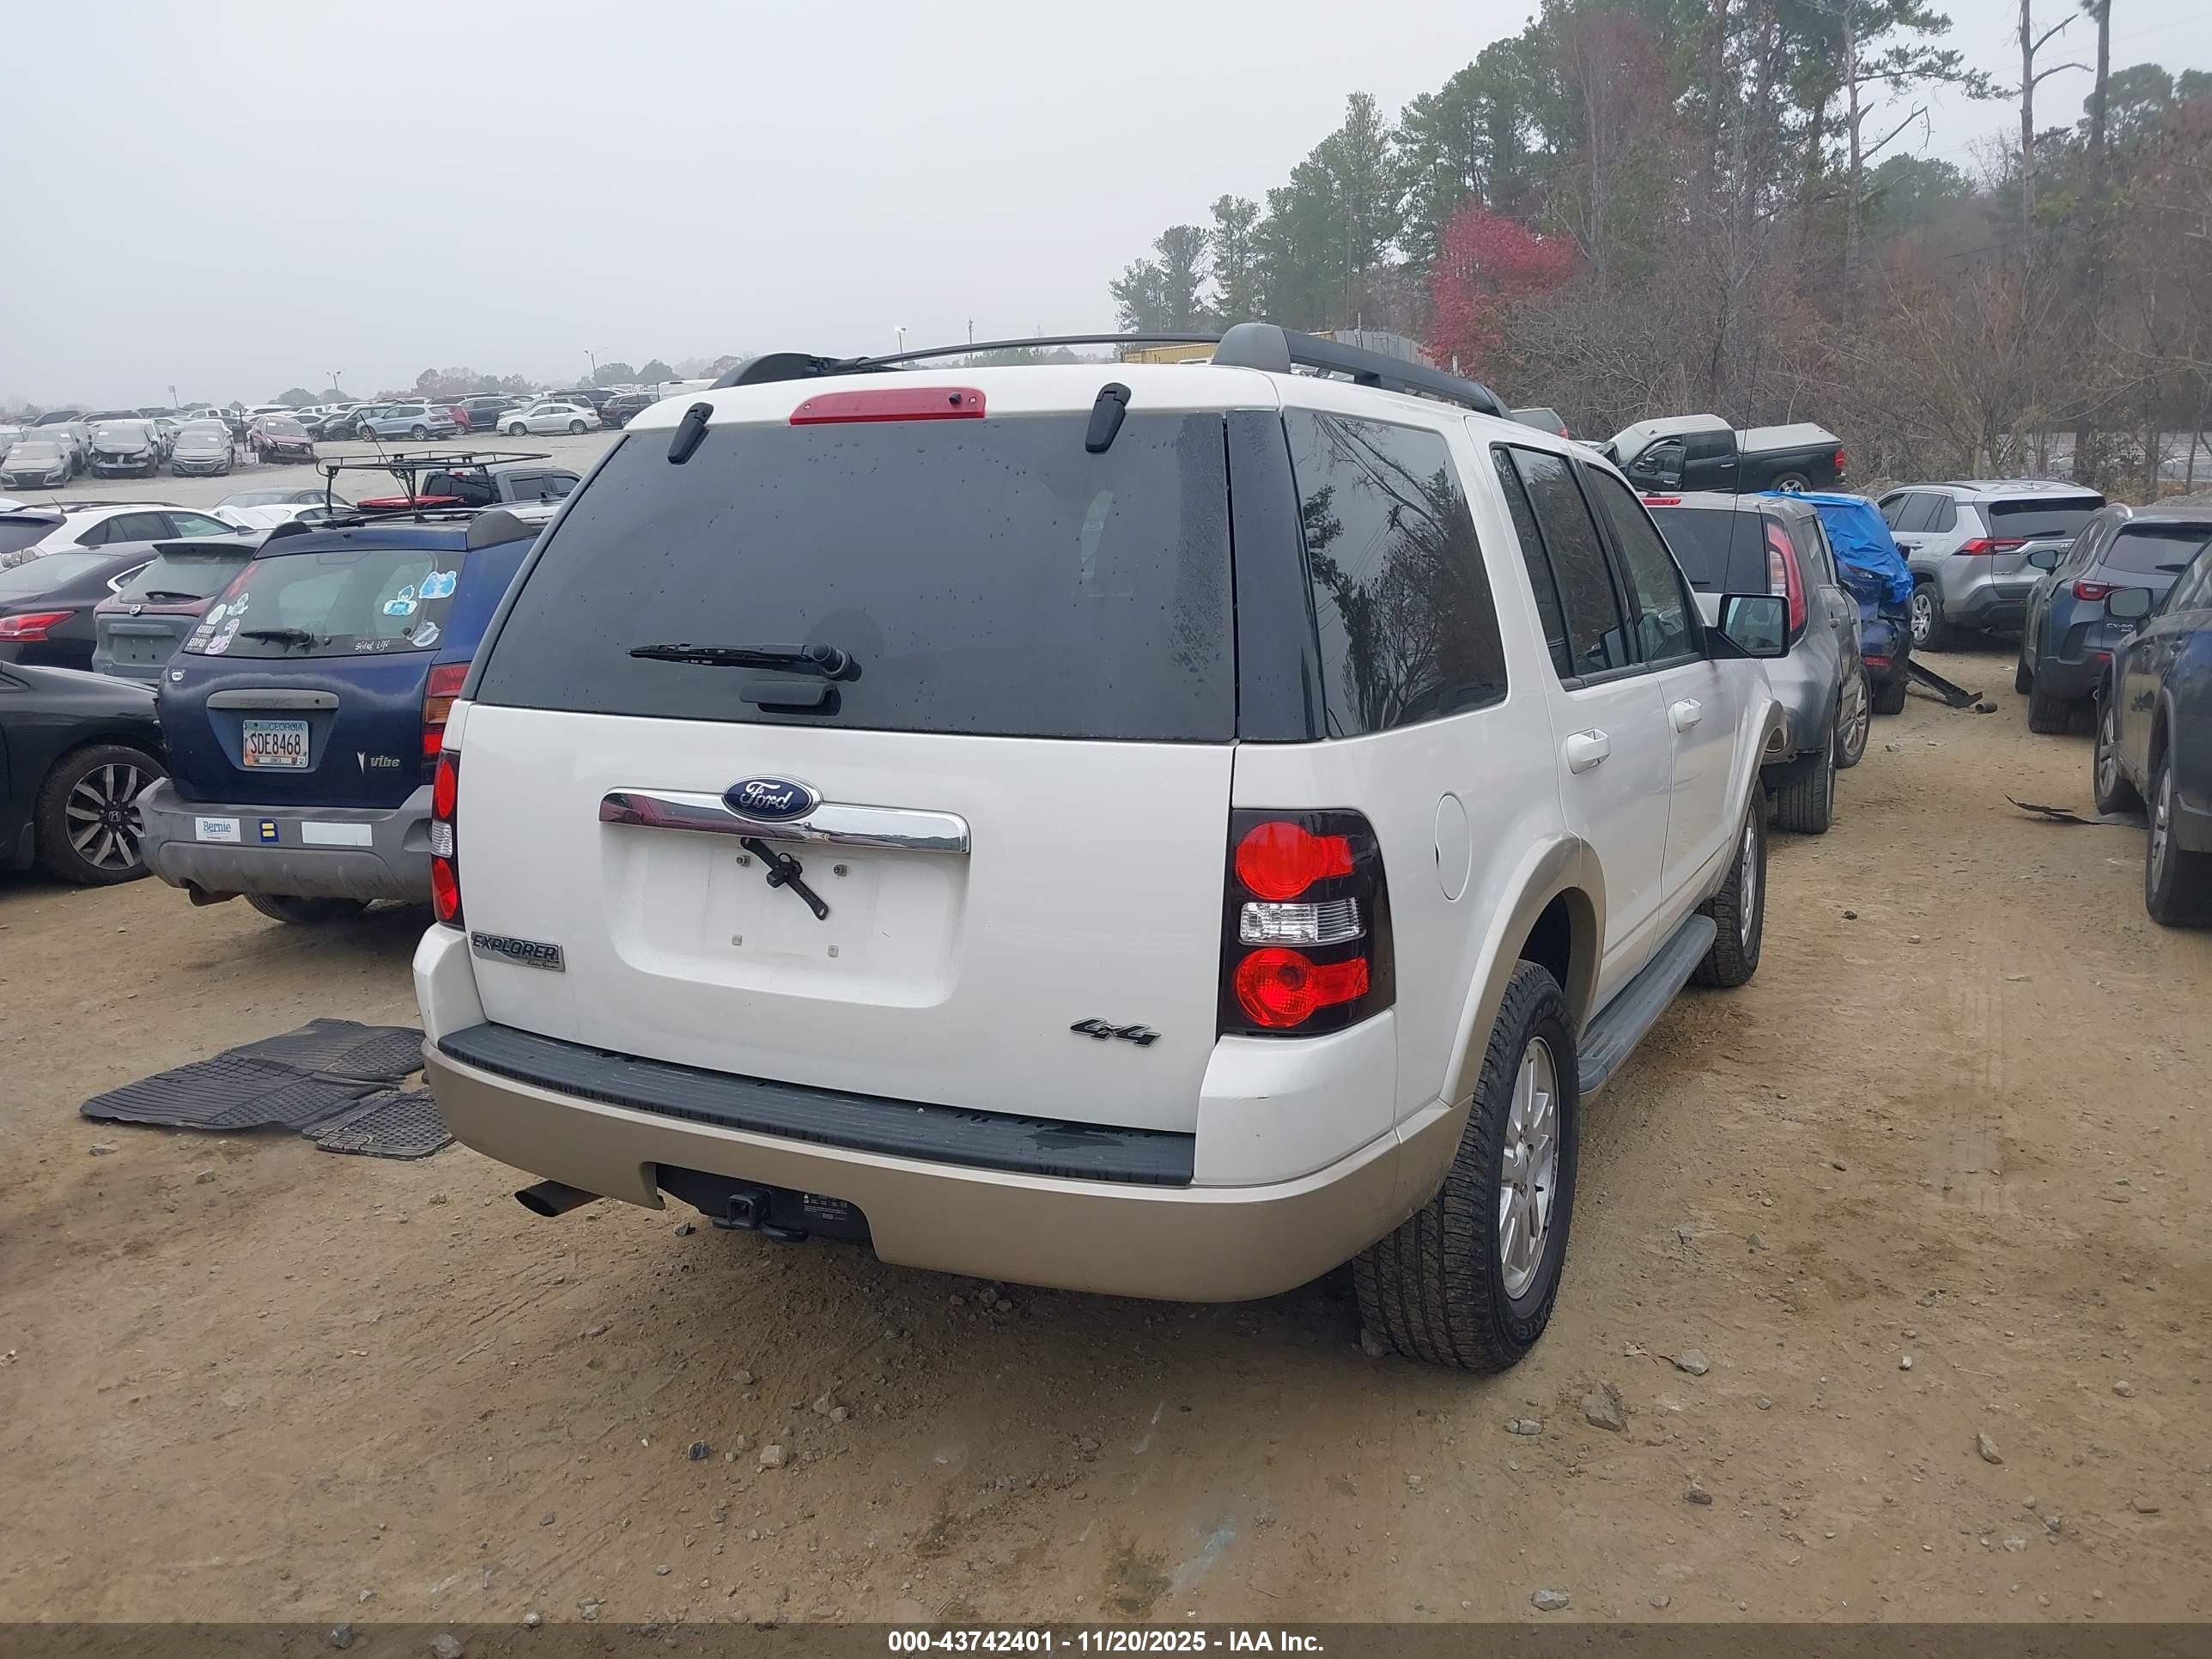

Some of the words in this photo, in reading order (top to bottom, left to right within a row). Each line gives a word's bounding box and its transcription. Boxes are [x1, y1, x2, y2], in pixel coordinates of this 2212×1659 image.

[269, 722, 303, 732] GEORGIA
[250, 732, 301, 756] SDE8468
[739, 781, 793, 811] Ford
[203, 821, 231, 833] Bernie
[472, 933, 560, 963] EXPLORER
[1070, 1017, 1161, 1048] 4x4
